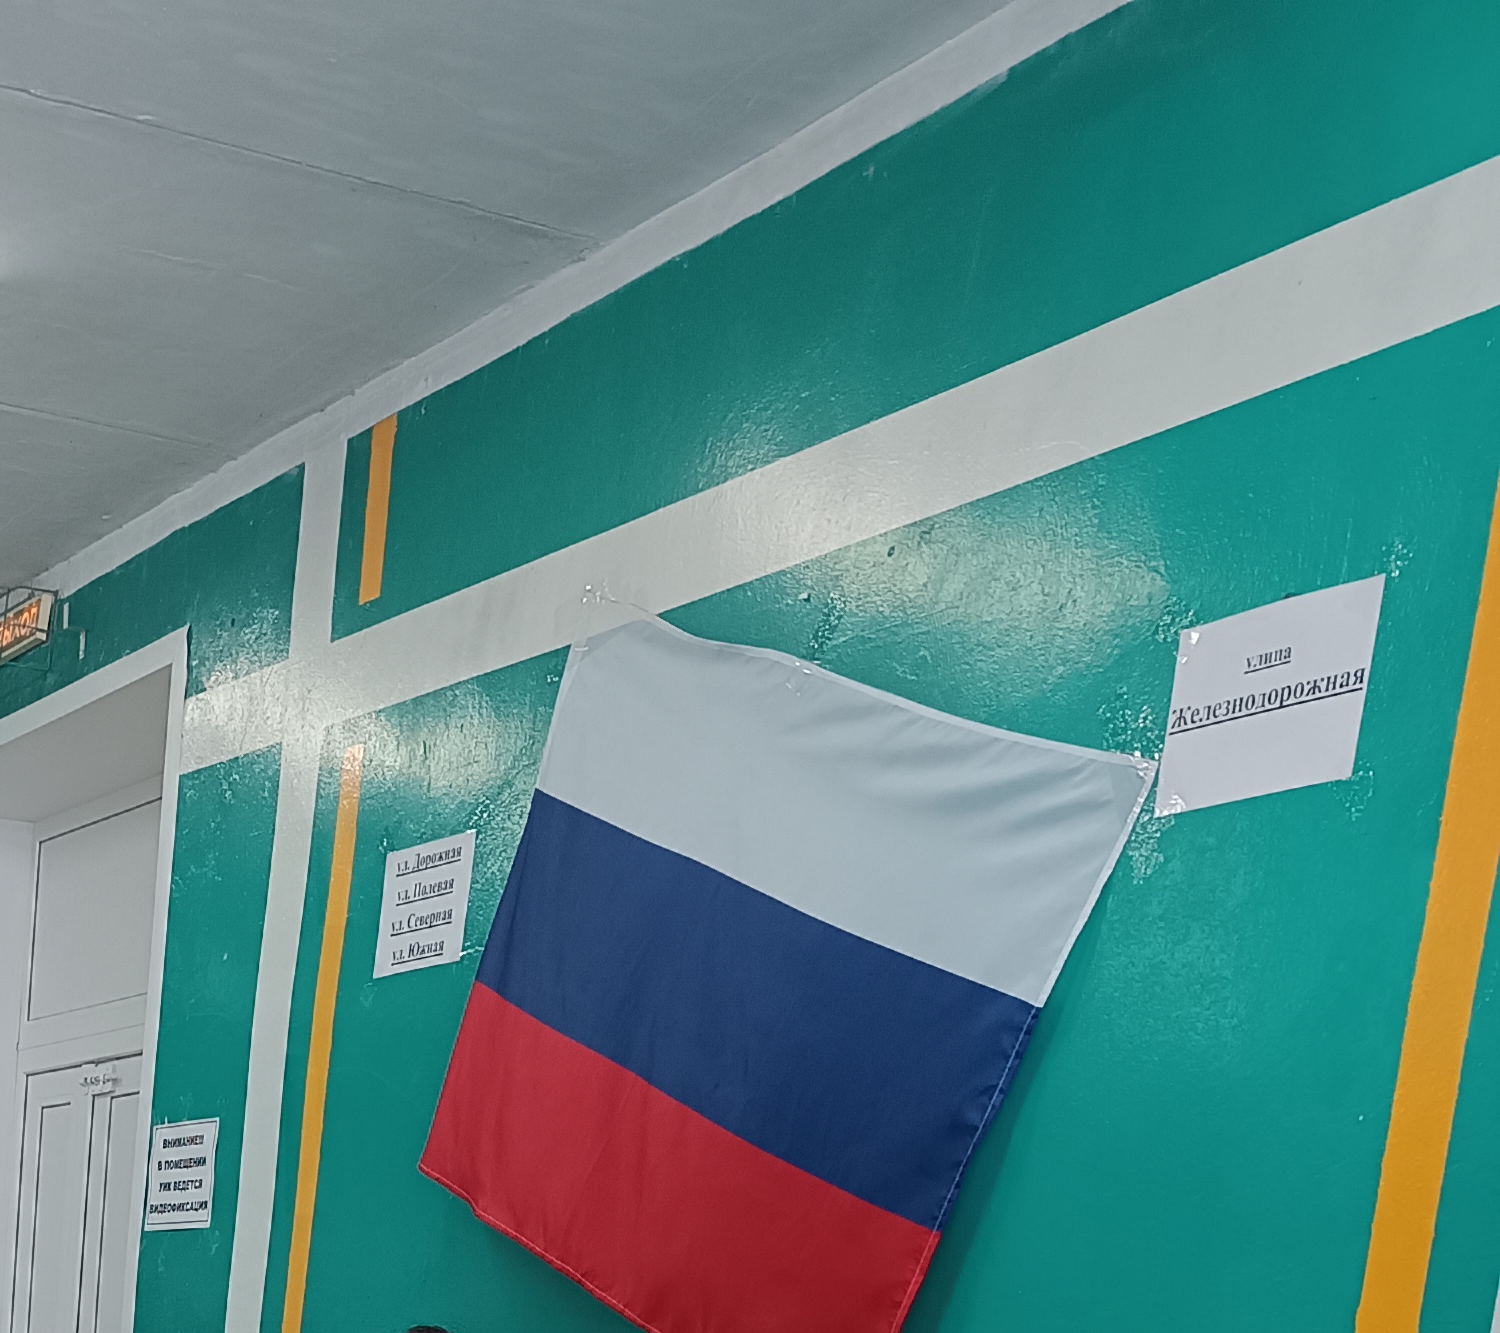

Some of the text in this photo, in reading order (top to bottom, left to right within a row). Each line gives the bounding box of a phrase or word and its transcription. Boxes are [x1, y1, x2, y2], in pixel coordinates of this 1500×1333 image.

[1245, 645, 1292, 671] улица
[1170, 667, 1366, 731] Железнодорожная
[412, 846, 462, 871] Дорожная
[413, 878, 455, 899] Полевая
[407, 908, 453, 929] Северная
[407, 940, 445, 959] Южная
[158, 1156, 207, 1171] В ПОМЕЩЕНИИ
[159, 1179, 203, 1193] УИК ВЕДЕТСЯ
[149, 1200, 208, 1215] ВИДЕОФИКСАЦИЯ
